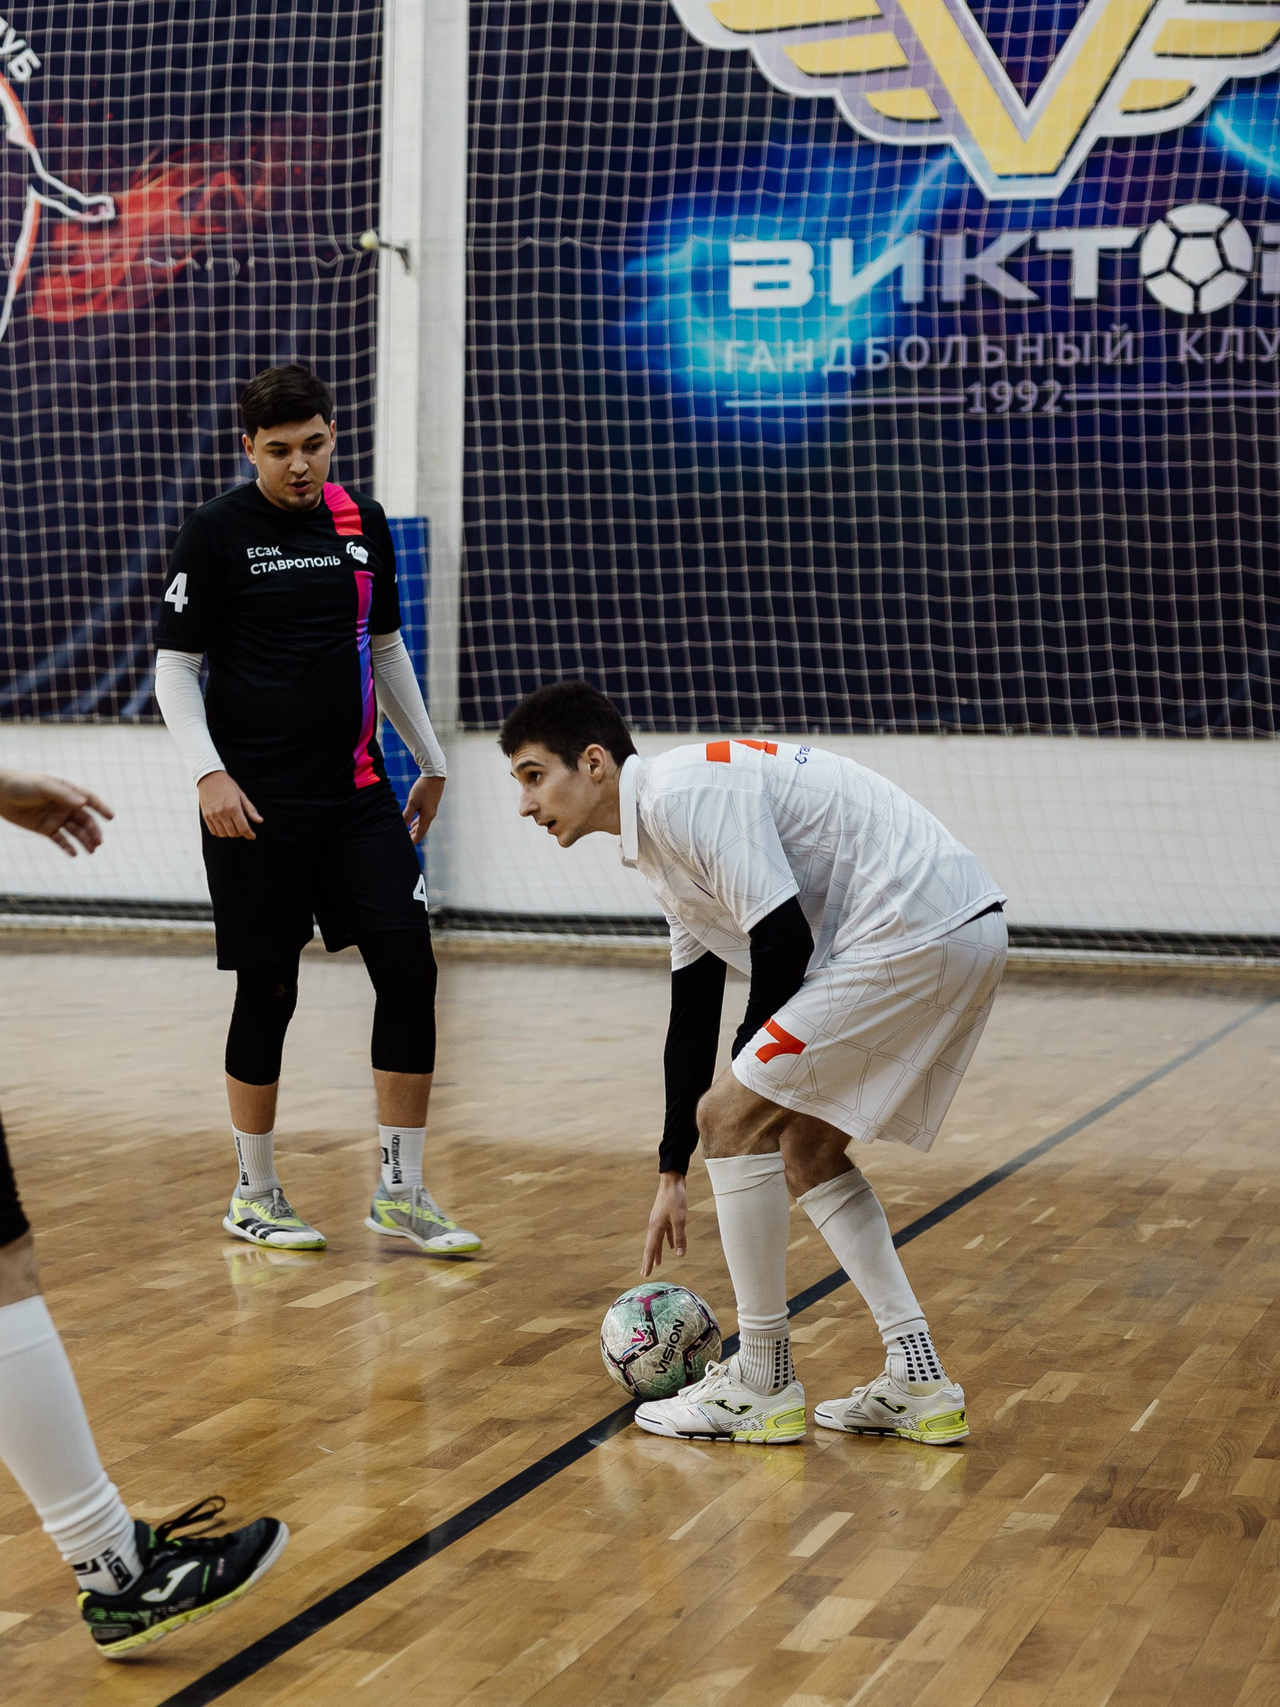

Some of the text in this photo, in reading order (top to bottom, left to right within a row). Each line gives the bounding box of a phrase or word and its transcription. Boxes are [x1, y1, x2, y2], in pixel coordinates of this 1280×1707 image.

[721, 323, 1280, 377] ГАНДБОЛЬНЫЙ КЛУ
[965, 380, 1063, 414] 1992
[250, 555, 341, 575] СТАВРОПОЛЬ
[164, 572, 188, 613] 4
[412, 873, 429, 912] 4
[654, 1318, 685, 1374] VISION
